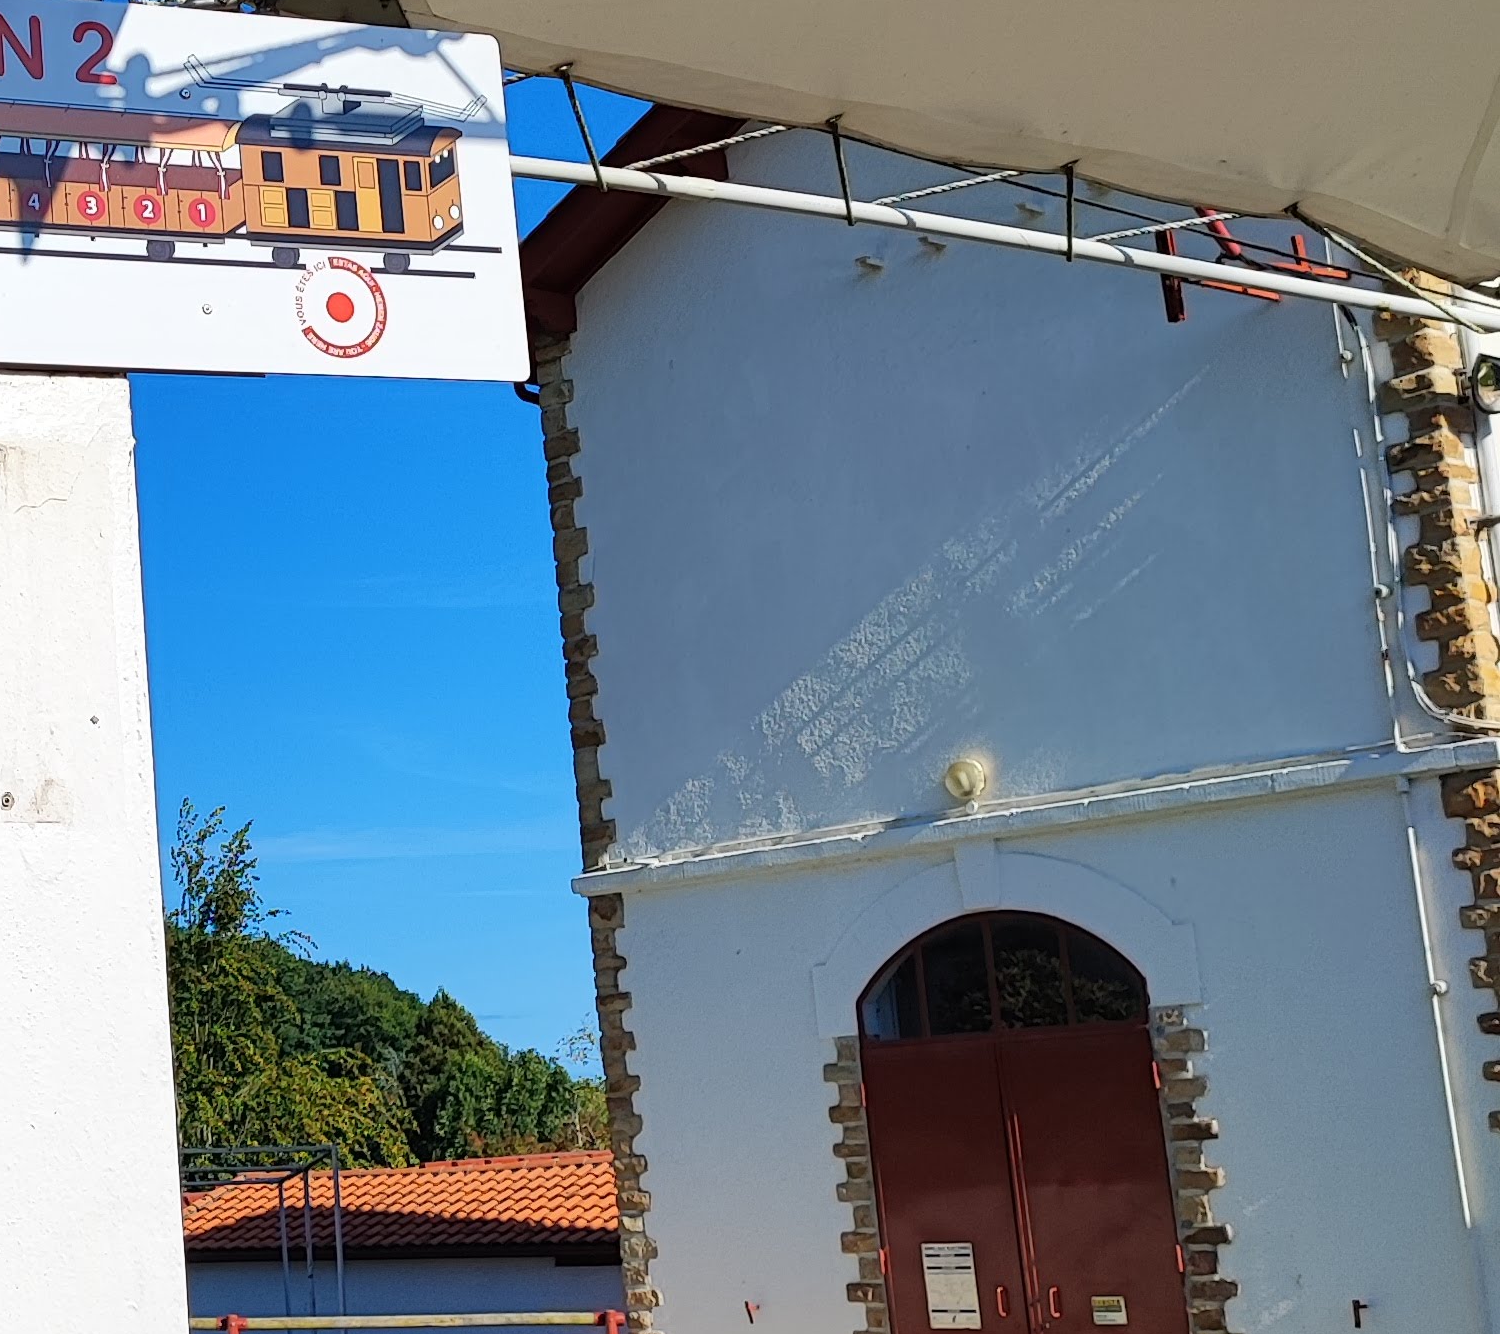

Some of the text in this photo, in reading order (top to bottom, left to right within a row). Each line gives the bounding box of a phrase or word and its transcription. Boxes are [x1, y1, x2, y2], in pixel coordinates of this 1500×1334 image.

[72, 21, 118, 85] 2
[28, 193, 41, 211] 4
[85, 196, 98, 216] 3
[141, 200, 155, 219] 2
[196, 203, 207, 222] 1
[295, 296, 306, 325] VOUS
[313, 261, 326, 272] ICI
